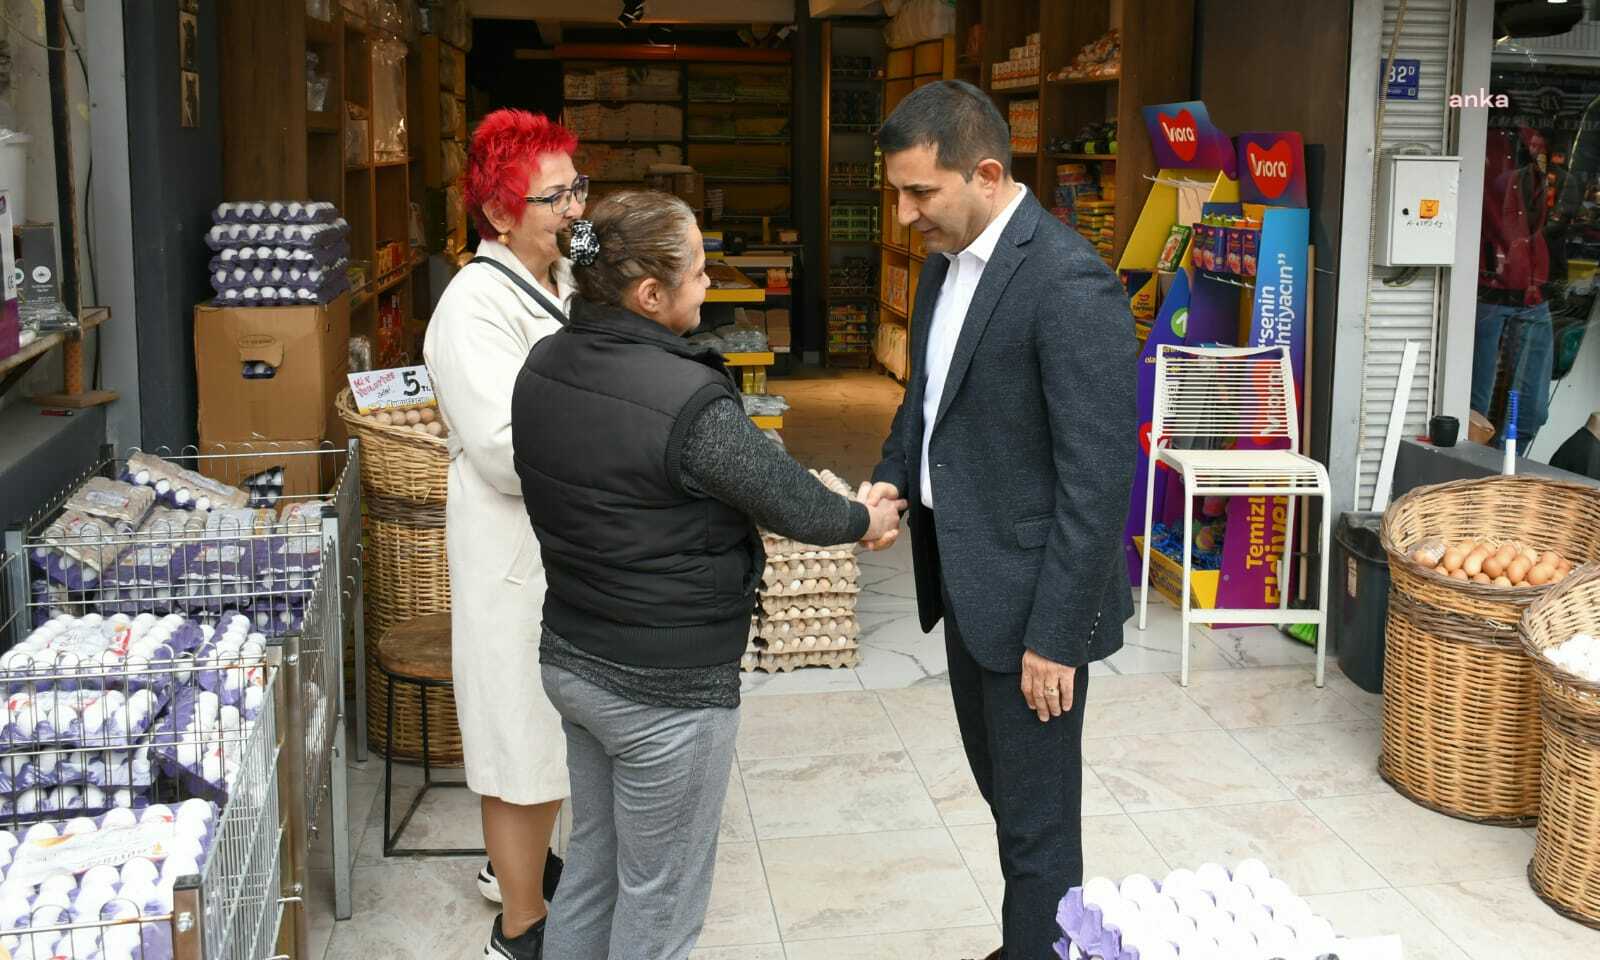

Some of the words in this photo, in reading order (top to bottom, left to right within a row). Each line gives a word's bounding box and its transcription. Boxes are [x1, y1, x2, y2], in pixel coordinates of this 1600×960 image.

[1250, 152, 1288, 178] Viora
[402, 370, 421, 397] 5
[1245, 482, 1265, 570] Temizl
